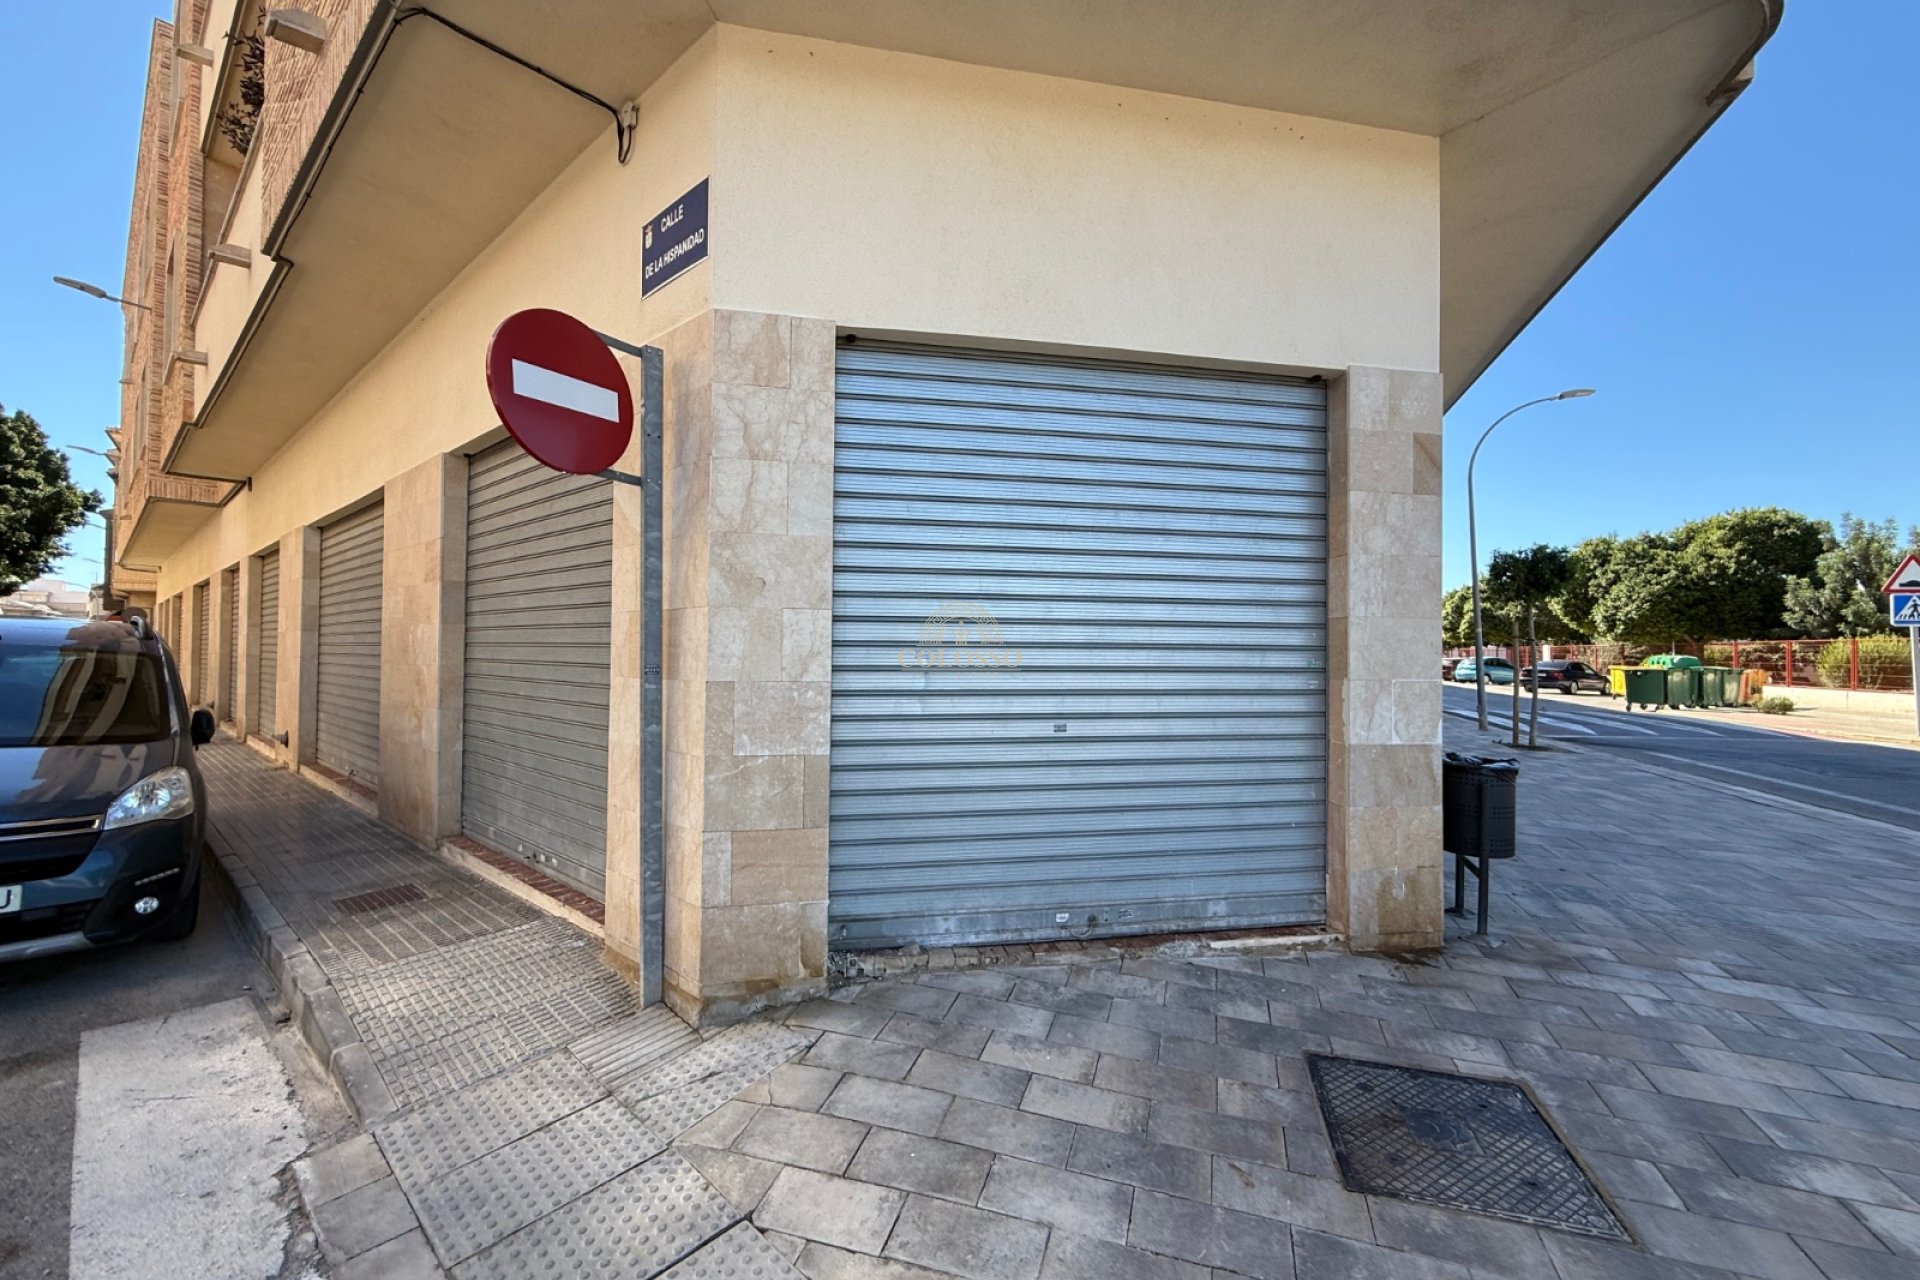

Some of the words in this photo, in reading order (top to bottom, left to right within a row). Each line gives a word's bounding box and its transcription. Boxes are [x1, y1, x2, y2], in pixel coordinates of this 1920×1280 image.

[661, 204, 683, 232] CALLE
[645, 262, 654, 279] DE
[655, 256, 663, 273] LA
[663, 228, 704, 266] HISPANIDAD
